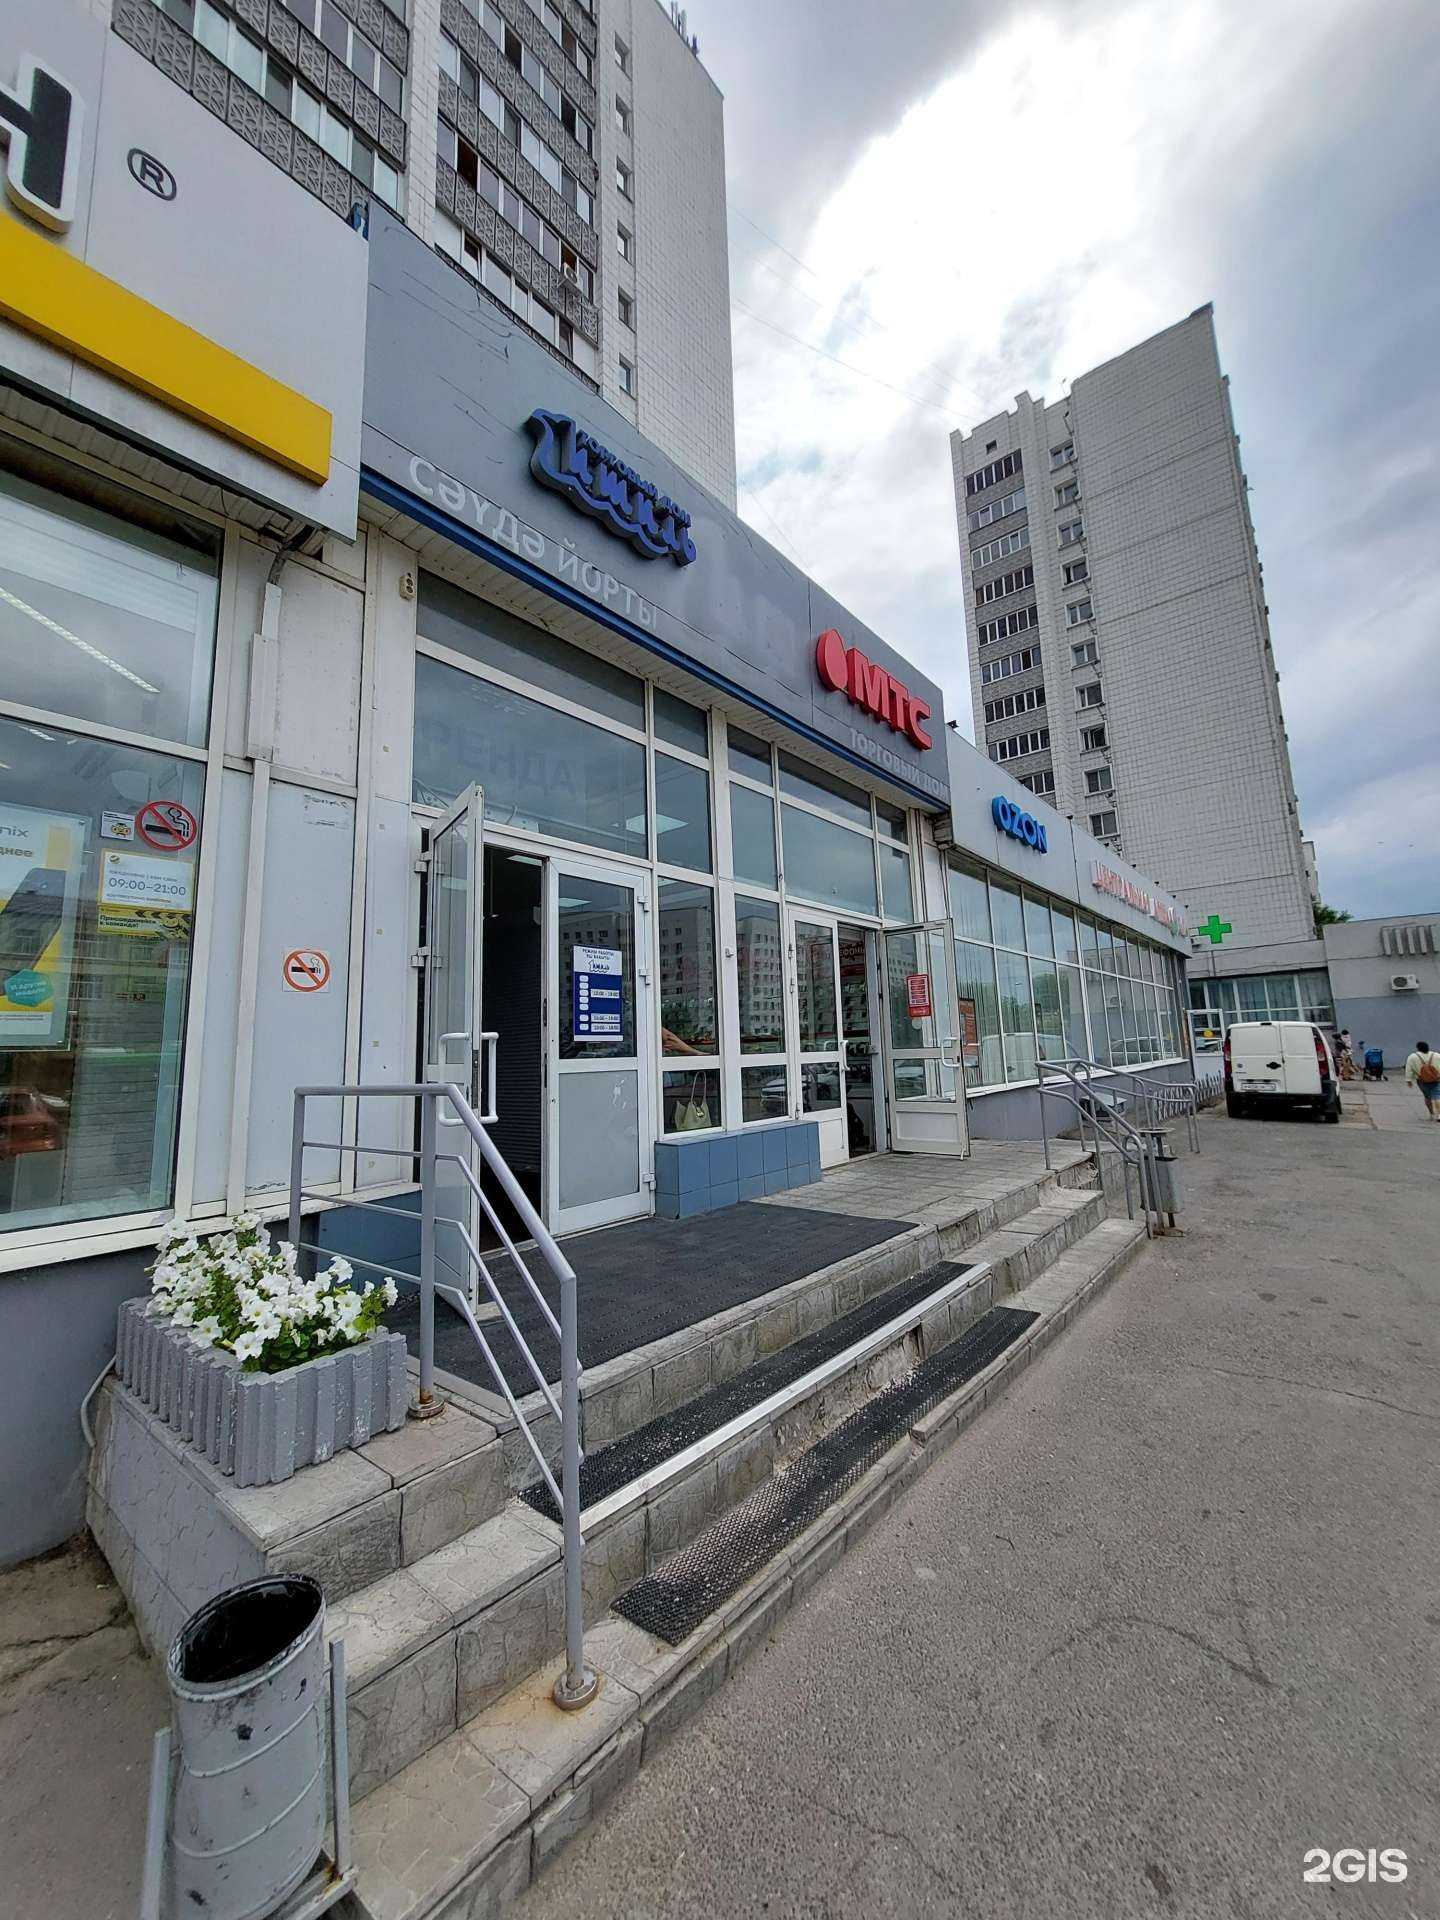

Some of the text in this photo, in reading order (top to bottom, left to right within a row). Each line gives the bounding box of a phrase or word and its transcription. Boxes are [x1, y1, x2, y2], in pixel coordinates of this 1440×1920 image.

[409, 455, 658, 630] СӘҮДӘ ЙОРТЫ
[846, 647, 934, 752] МТС
[992, 795, 1048, 854] OZON
